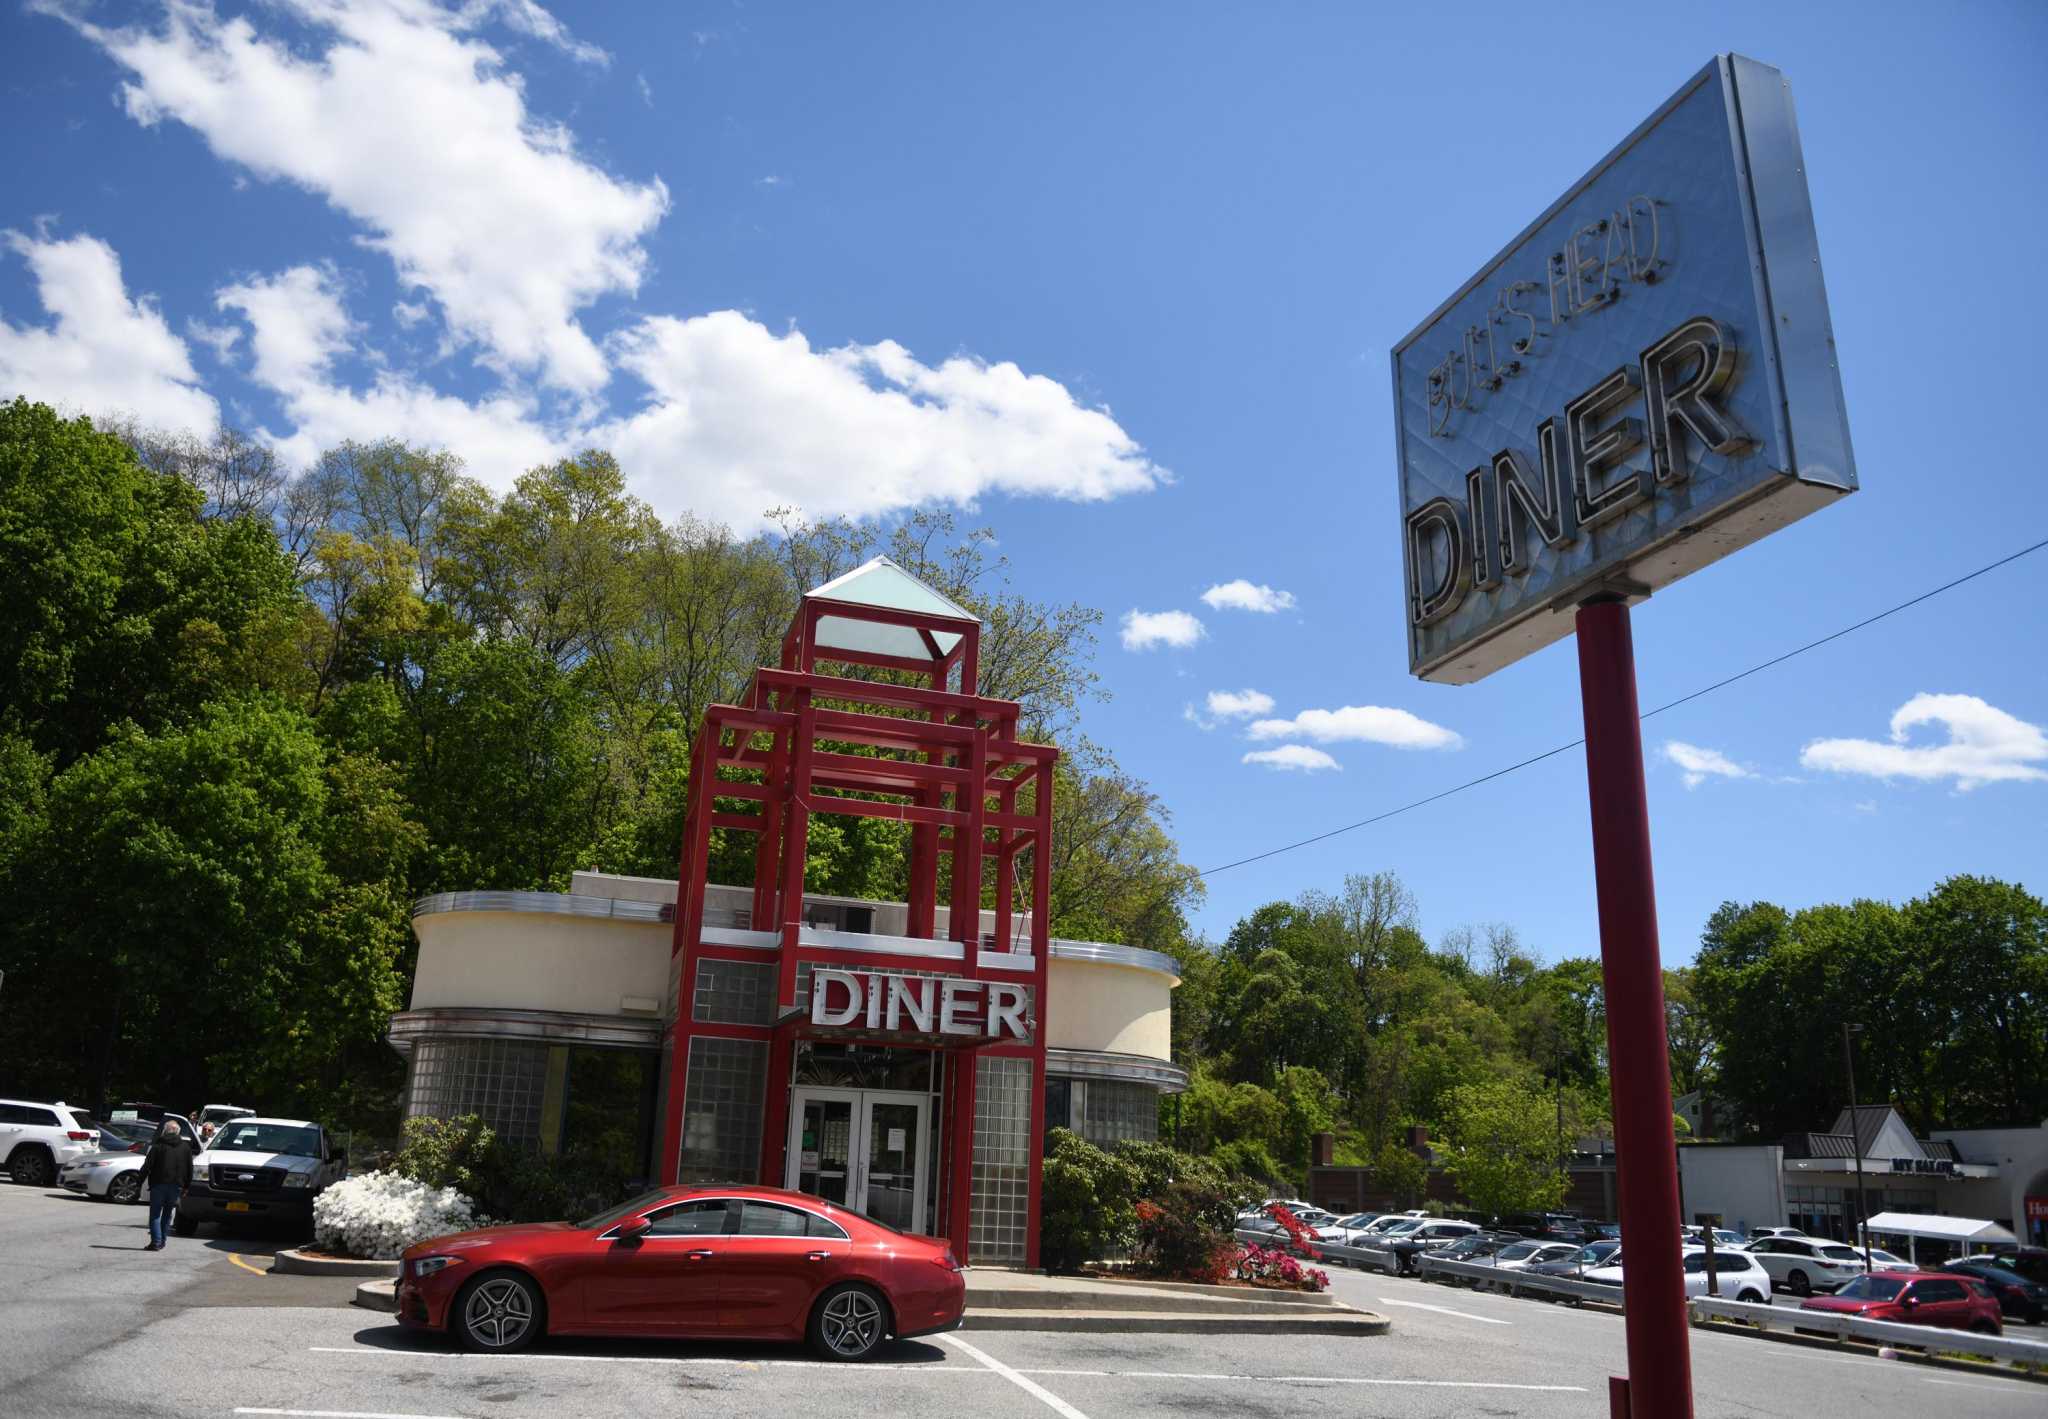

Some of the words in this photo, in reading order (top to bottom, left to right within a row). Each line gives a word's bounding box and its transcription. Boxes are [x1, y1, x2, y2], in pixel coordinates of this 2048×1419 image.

[1426, 280, 1539, 439] BULL'S
[1547, 194, 1658, 327] HEAD
[1405, 315, 1750, 628] DINER
[811, 968, 1032, 1040] DINER
